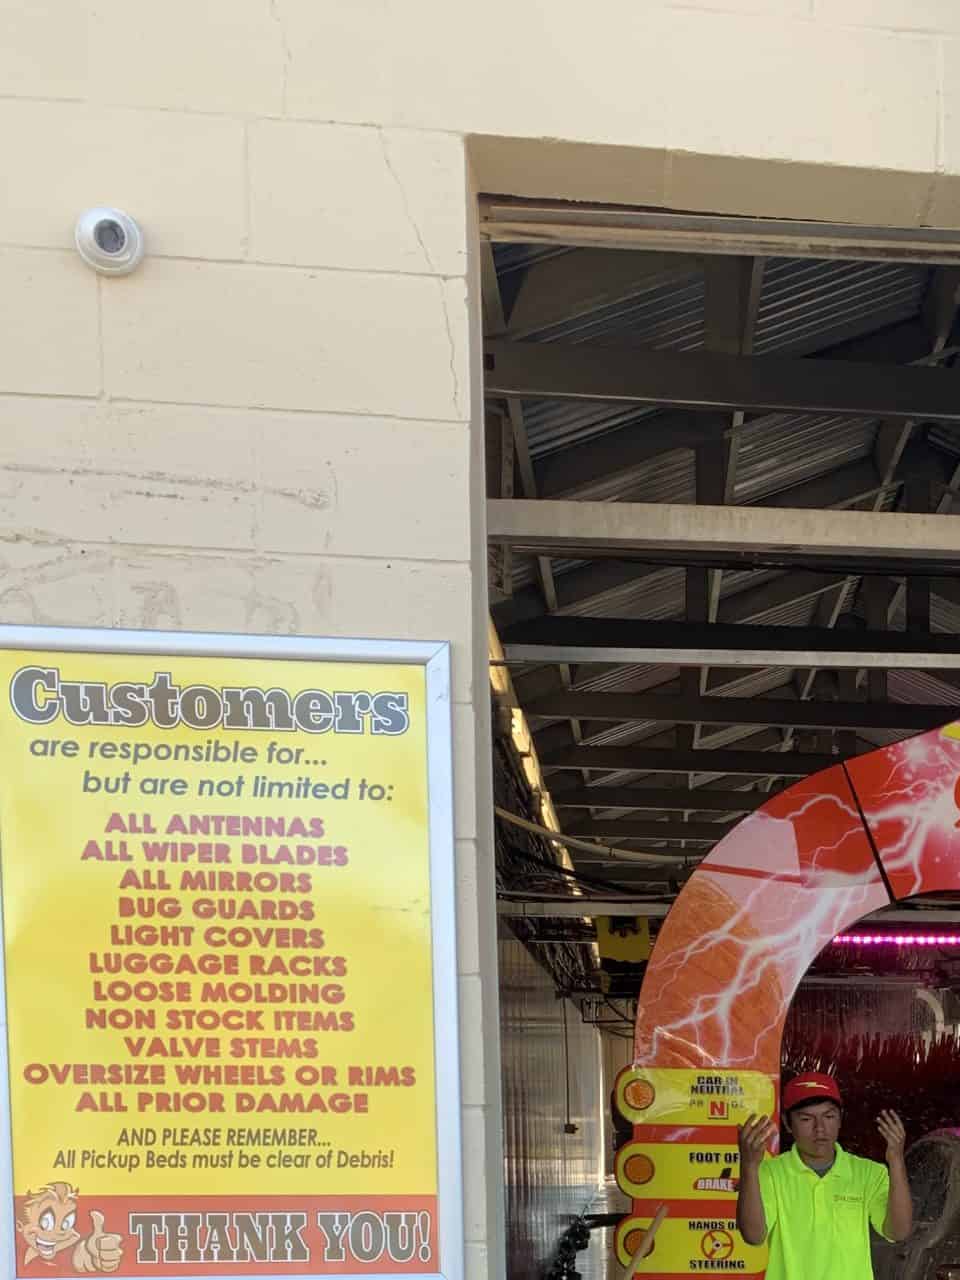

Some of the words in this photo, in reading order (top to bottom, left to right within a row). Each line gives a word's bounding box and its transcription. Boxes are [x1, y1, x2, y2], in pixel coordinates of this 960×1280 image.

[10, 665, 410, 735] Customers
[29, 737, 80, 758] are
[88, 739, 258, 765] responsible
[267, 743, 327, 766] for...
[82, 770, 131, 794] but
[139, 776, 188, 796] are
[198, 775, 244, 797] not
[252, 775, 350, 800] limited
[359, 779, 394, 801] to:
[105, 813, 156, 835] ALL
[165, 814, 325, 839] ANTENNAS
[81, 840, 132, 861] ALL
[144, 843, 230, 864] WIPER
[241, 845, 349, 866] BLADES
[119, 869, 170, 890] ALL
[180, 870, 312, 893] MIRRORS
[118, 897, 182, 919] BUG
[192, 899, 315, 921] GUARDS
[111, 925, 194, 946] LIGHT
[205, 926, 325, 949] COVERS
[89, 953, 239, 975] LUGGAGE
[249, 955, 347, 977] RACKS
[93, 980, 192, 1002] LOOSE
[201, 982, 345, 1004] MOLDING
[85, 1009, 155, 1029] NON
[166, 1010, 265, 1030] STOCK
[274, 1011, 355, 1032] ITEMS
[124, 1037, 220, 1058] VALVE
[229, 1038, 319, 1059] STEMS
[23, 1064, 165, 1086] OVERSIZE
[175, 1065, 285, 1086] WHEELS
[295, 1066, 337, 1086] OR
[349, 1067, 416, 1086] RIMS
[76, 1092, 128, 1113] ALL
[138, 1093, 226, 1113] PRIOR
[235, 1093, 368, 1113] DAMAGE
[117, 1128, 158, 1146] AND
[162, 1128, 221, 1146] PLEASE
[227, 1129, 331, 1147] REMEMBER...
[53, 1150, 76, 1168] All
[81, 1150, 140, 1172] Pickup
[145, 1150, 187, 1168] Beds
[192, 1151, 233, 1168] must
[238, 1150, 261, 1168] be
[265, 1150, 311, 1168] clear
[315, 1150, 333, 1168] of
[337, 1151, 395, 1168] Debris!
[689, 1153, 721, 1164] FOOT
[724, 1153, 739, 1164] OF
[697, 1178, 734, 1191] BRAKE
[129, 1211, 309, 1263] THANK
[317, 1210, 431, 1263] YOU!
[689, 1221, 725, 1231] HANDS
[689, 1260, 745, 1270] STEERING
